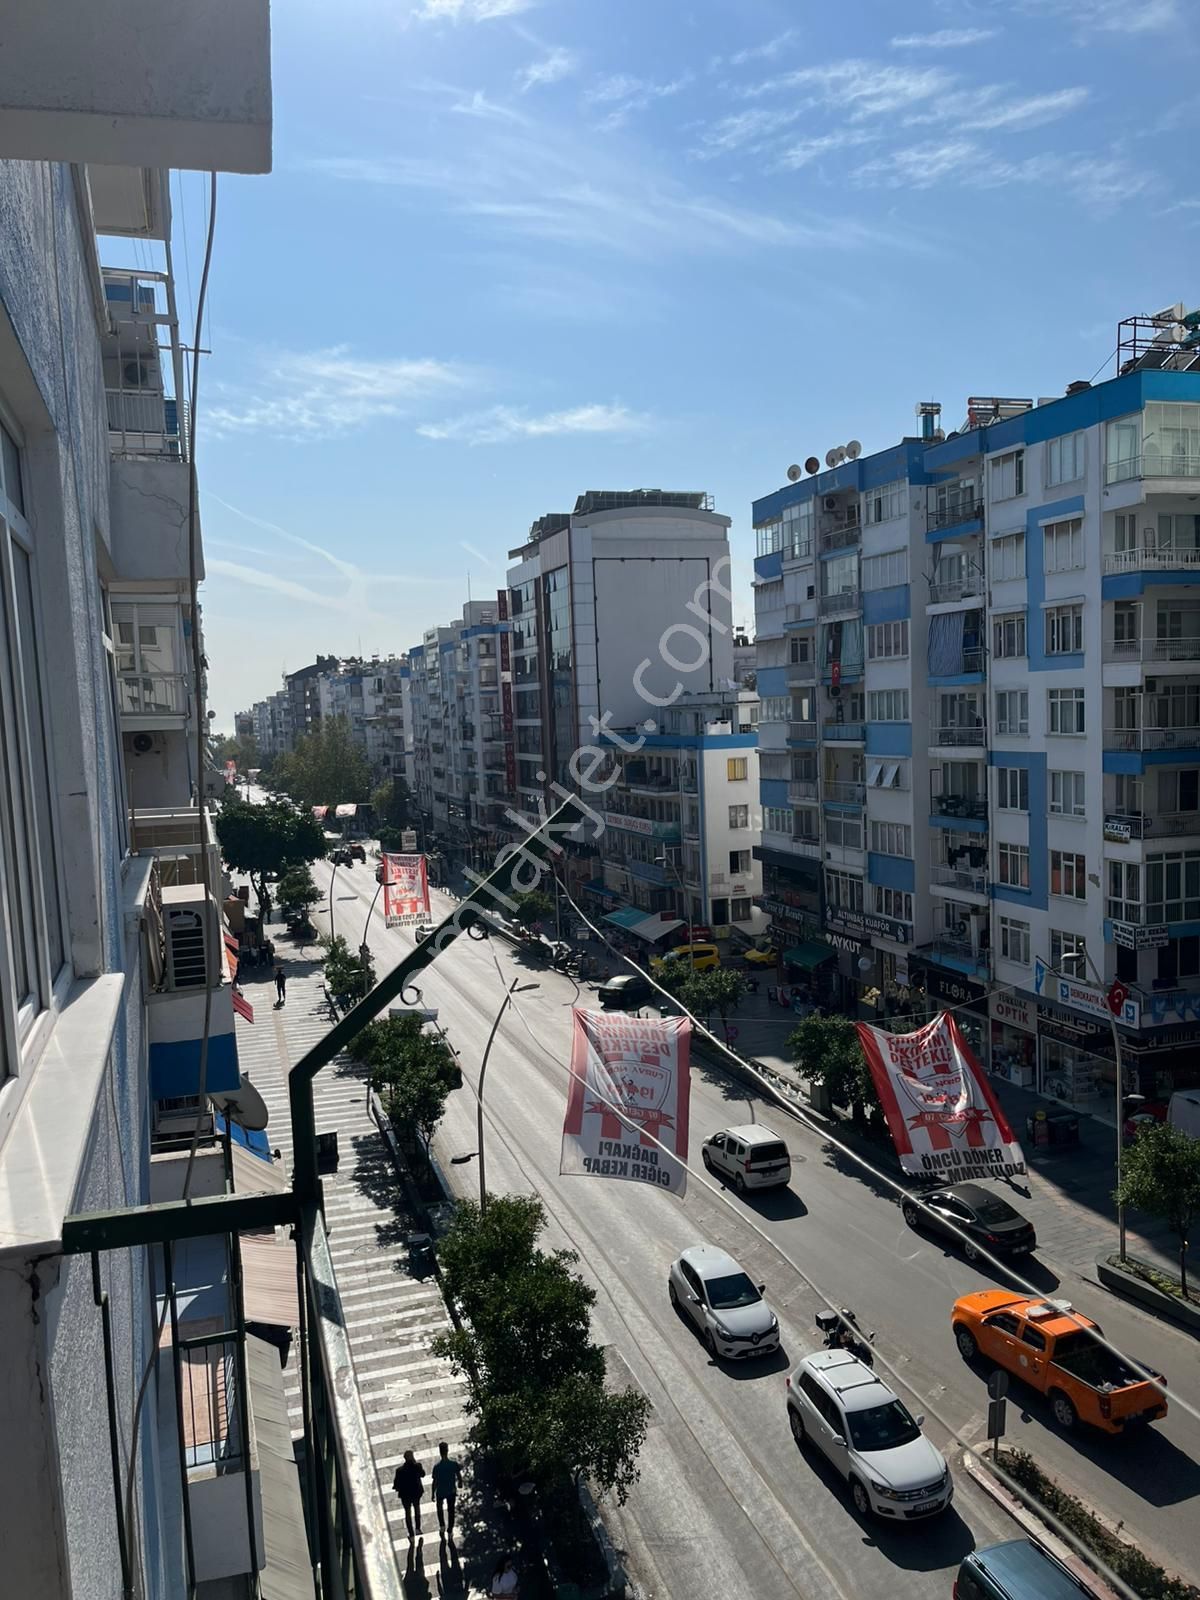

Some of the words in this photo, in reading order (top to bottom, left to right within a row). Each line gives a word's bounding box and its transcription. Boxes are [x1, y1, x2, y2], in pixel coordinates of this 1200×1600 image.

[1105, 823, 1130, 833] KIRALIK
[837, 909, 864, 926] ALTINBAŞ
[865, 917, 890, 933] KUAFÖR
[831, 934, 862, 955] AYKUT
[939, 980, 973, 1001] FLORA
[995, 1003, 1030, 1025] OPTİK
[920, 1149, 962, 1170] ÖNCÜ
[963, 1147, 1005, 1165] DÖNER
